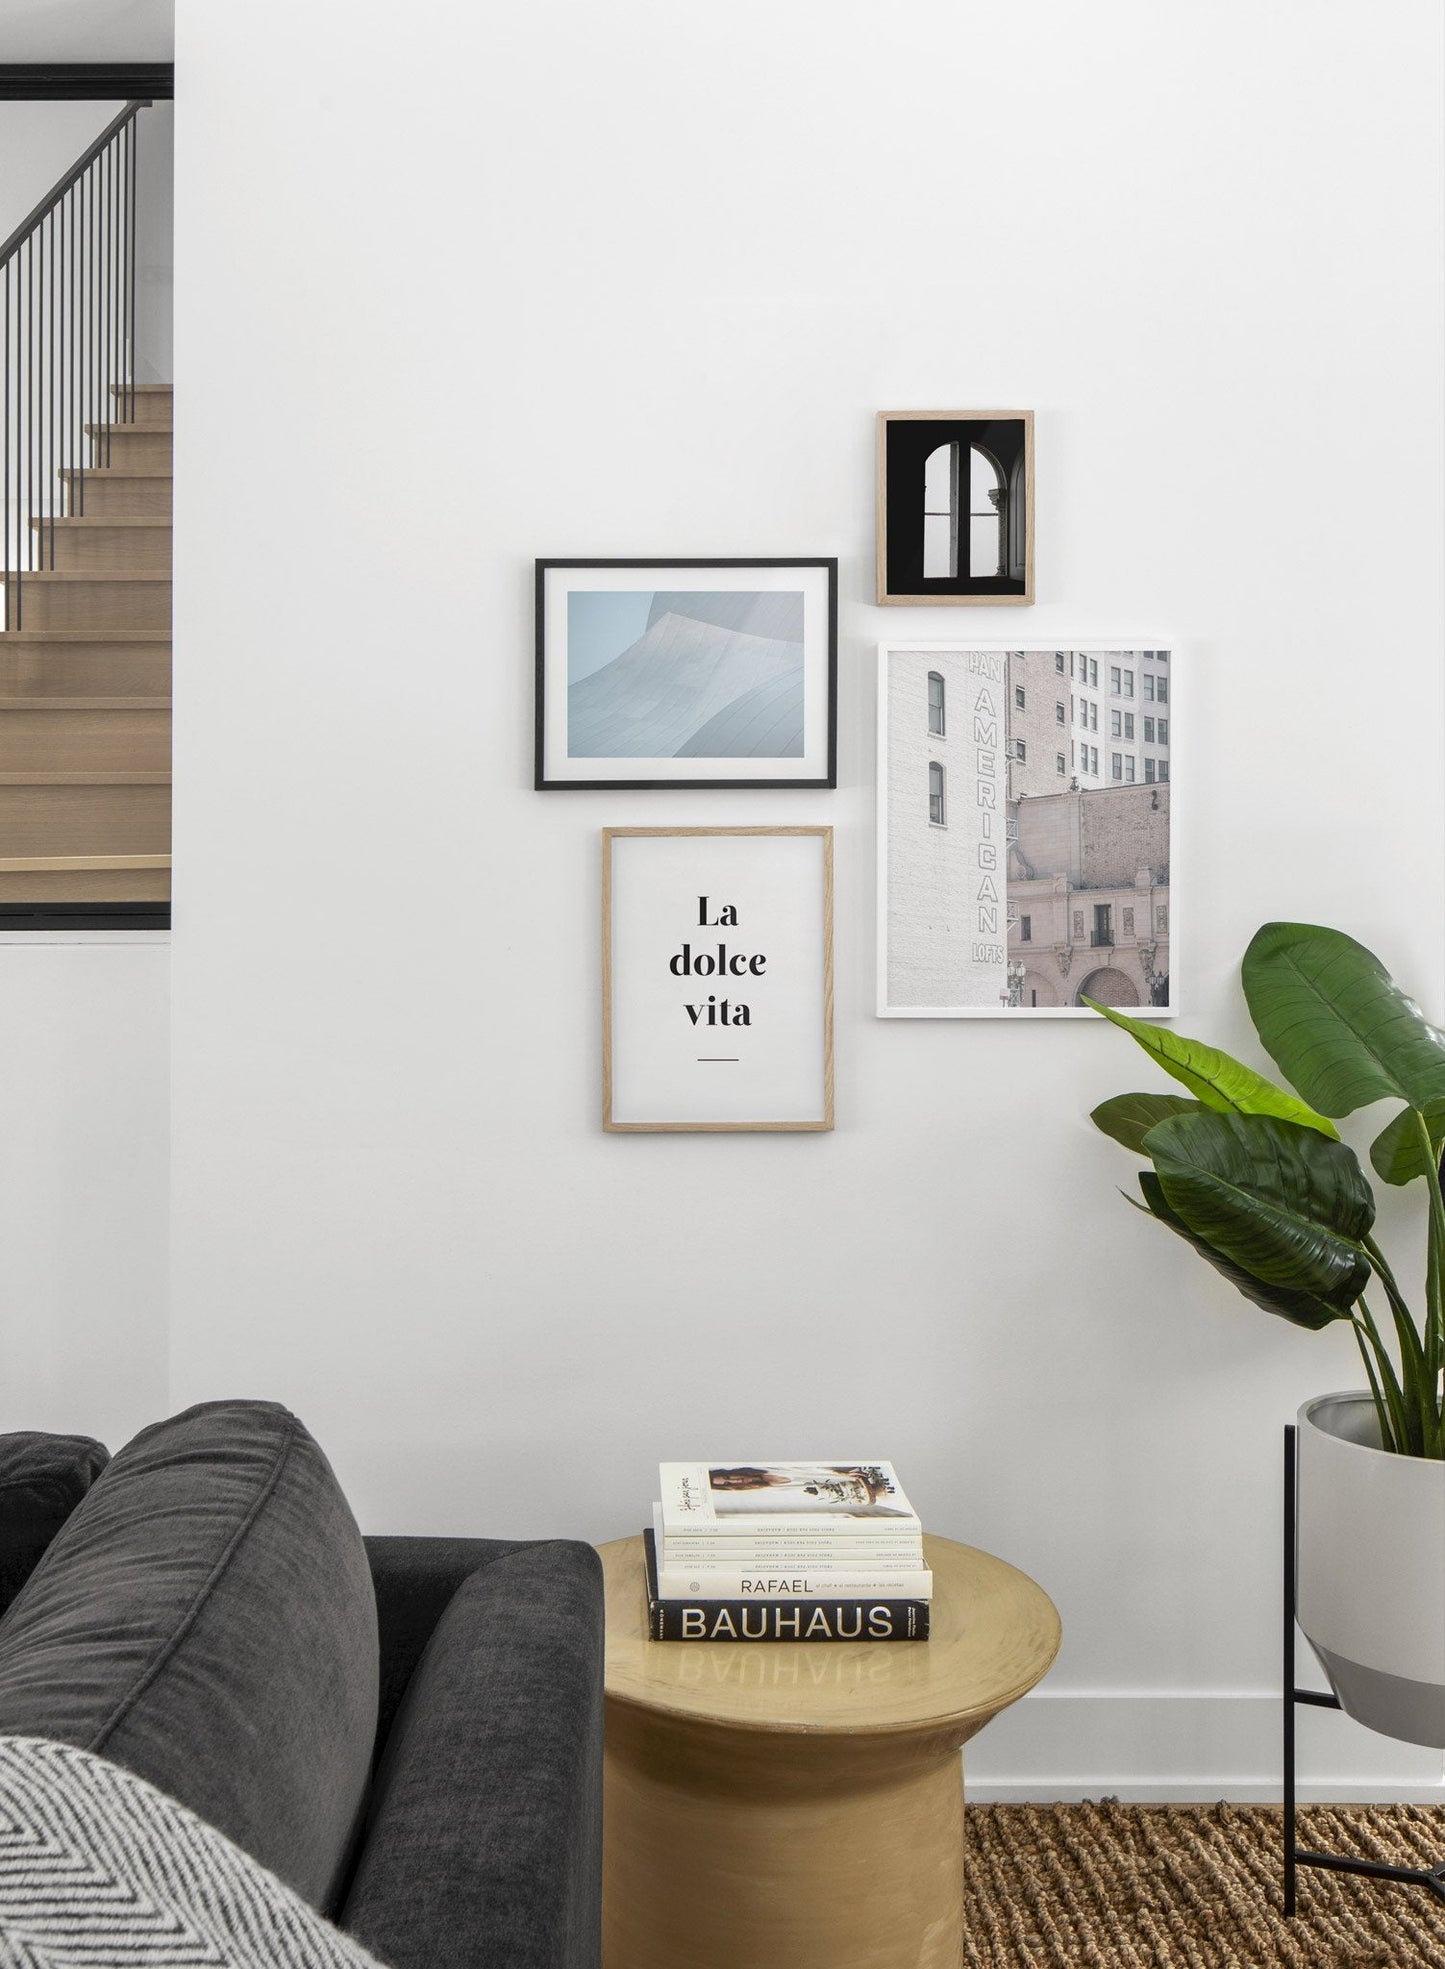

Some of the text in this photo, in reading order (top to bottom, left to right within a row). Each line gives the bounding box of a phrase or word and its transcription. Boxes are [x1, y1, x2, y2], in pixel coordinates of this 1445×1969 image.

[969, 651, 1001, 683] PAN
[974, 688, 998, 934] AMERICAN
[697, 896, 739, 927] La
[669, 943, 767, 976] dolce
[972, 943, 1004, 964] LOFTS
[683, 995, 752, 1026] vita
[740, 1579, 814, 1593] RAFAEL
[681, 1606, 894, 1639] BAUHAUS
